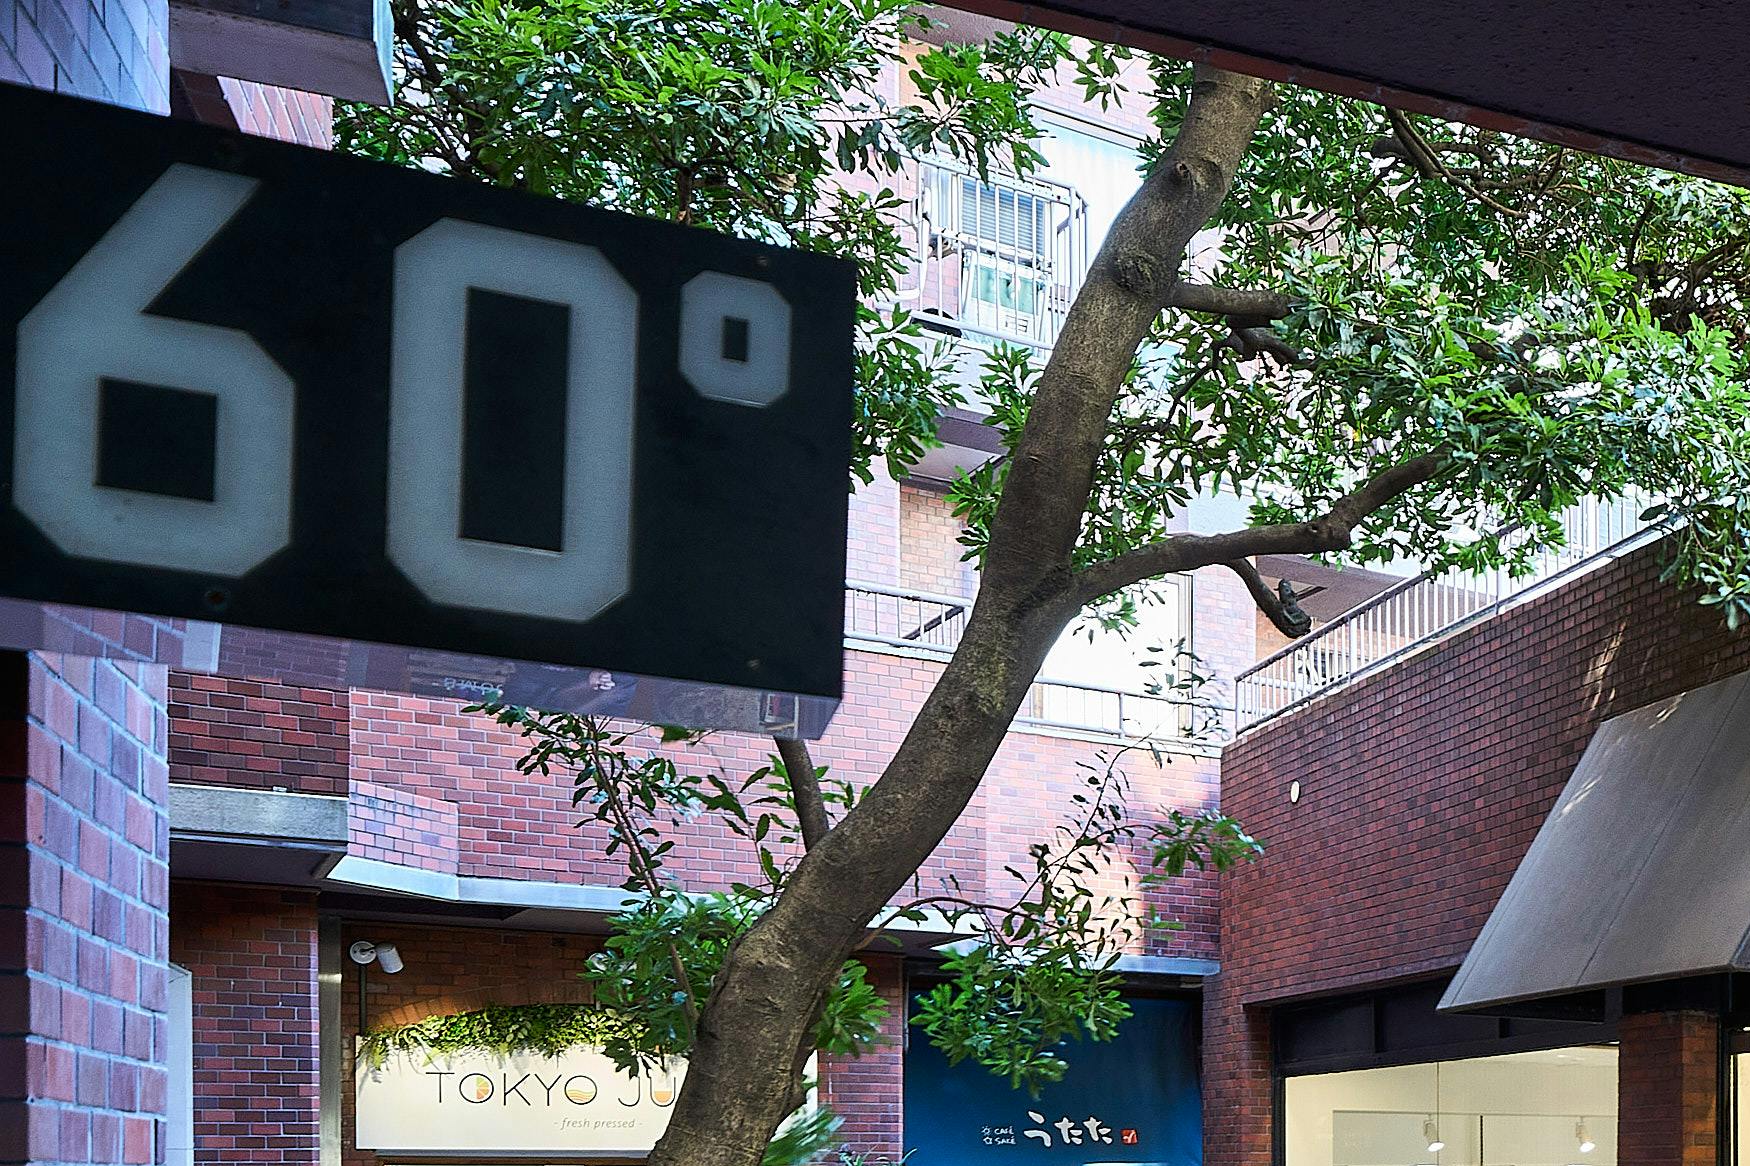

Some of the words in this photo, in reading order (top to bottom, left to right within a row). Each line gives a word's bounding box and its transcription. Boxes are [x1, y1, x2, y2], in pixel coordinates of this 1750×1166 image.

[425, 1072, 598, 1107] TOKYO
[560, 1117, 590, 1130] fresh
[593, 1118, 636, 1130] pressed
[1023, 1111, 1113, 1148] うたた
